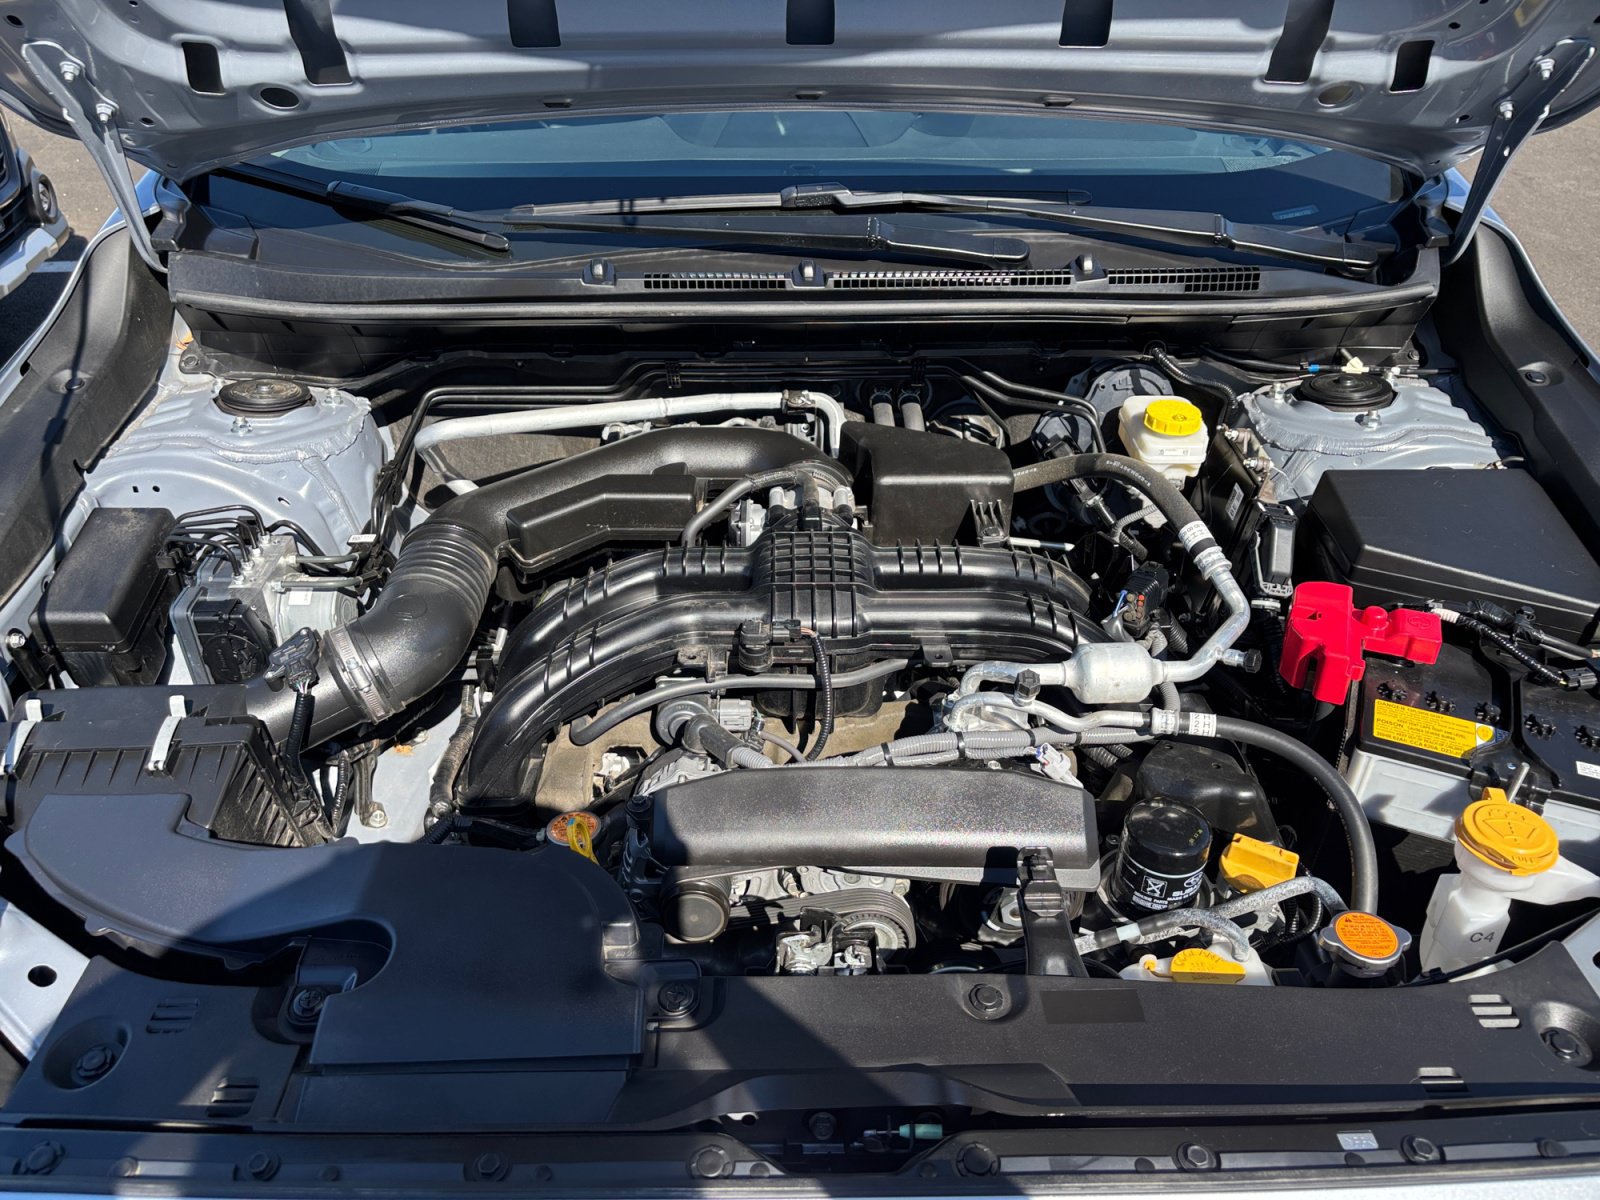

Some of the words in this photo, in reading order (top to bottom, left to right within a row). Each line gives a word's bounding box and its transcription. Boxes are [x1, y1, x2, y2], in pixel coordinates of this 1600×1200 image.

[1203, 720, 1211, 729] H
[1376, 718, 1403, 727] POISON
[1470, 931, 1496, 943] C4
